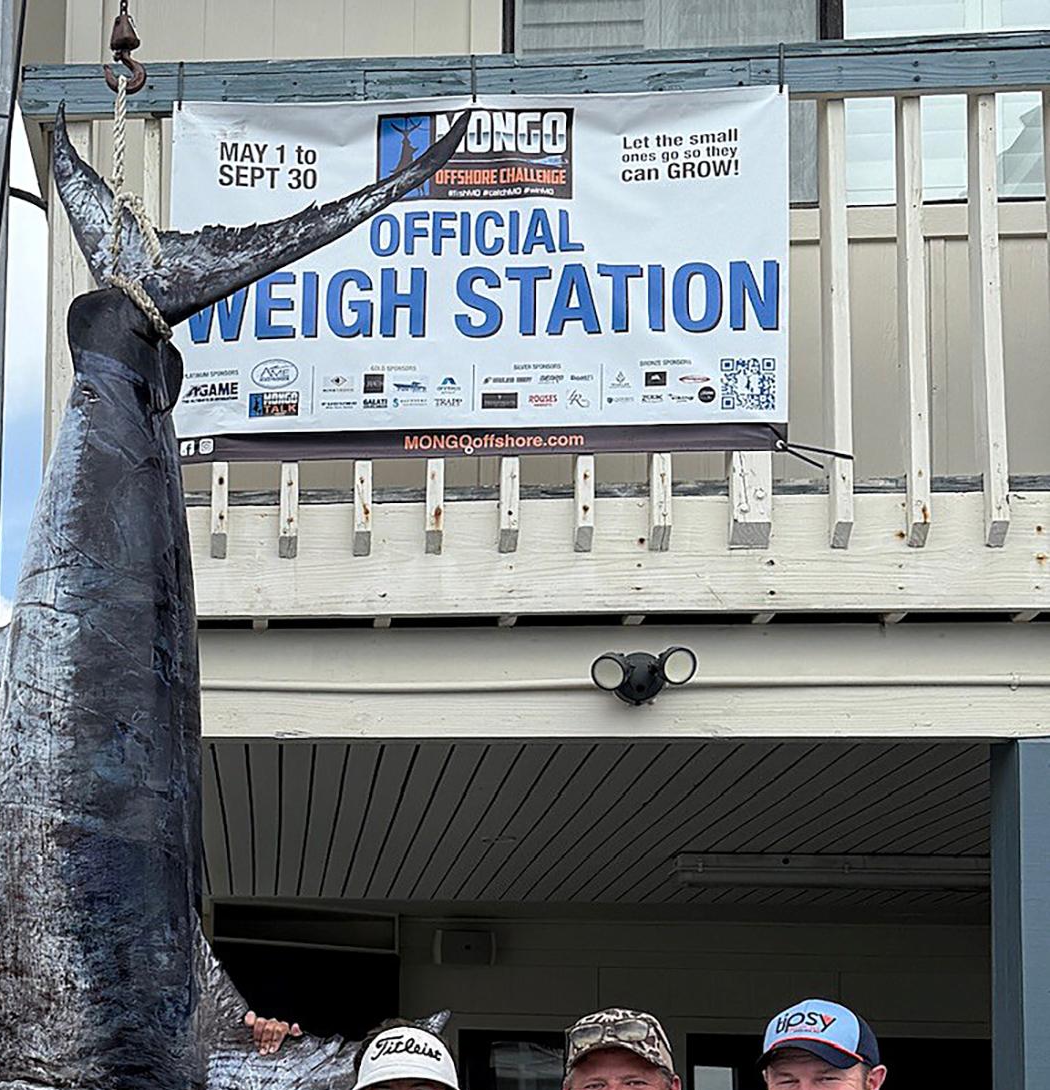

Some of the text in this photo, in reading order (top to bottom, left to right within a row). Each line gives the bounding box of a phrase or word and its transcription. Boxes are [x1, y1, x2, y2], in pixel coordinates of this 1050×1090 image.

[436, 111, 567, 154] MONGO
[623, 129, 738, 150] Let the small
[219, 142, 317, 165] MAY 1 to
[622, 146, 738, 165] ones go so they
[218, 167, 318, 189] SEPT 30
[435, 167, 566, 185] OFFSHORE CHALLENGE
[622, 163, 739, 181] can GROW!
[370, 208, 584, 257] OFFICIAL
[455, 260, 780, 337] STATION
[264, 404, 296, 414] TALK
[404, 432, 584, 449] MONGOoffshore.com
[776, 1012, 837, 1034] tipsy
[371, 1035, 442, 1061] Titleist
